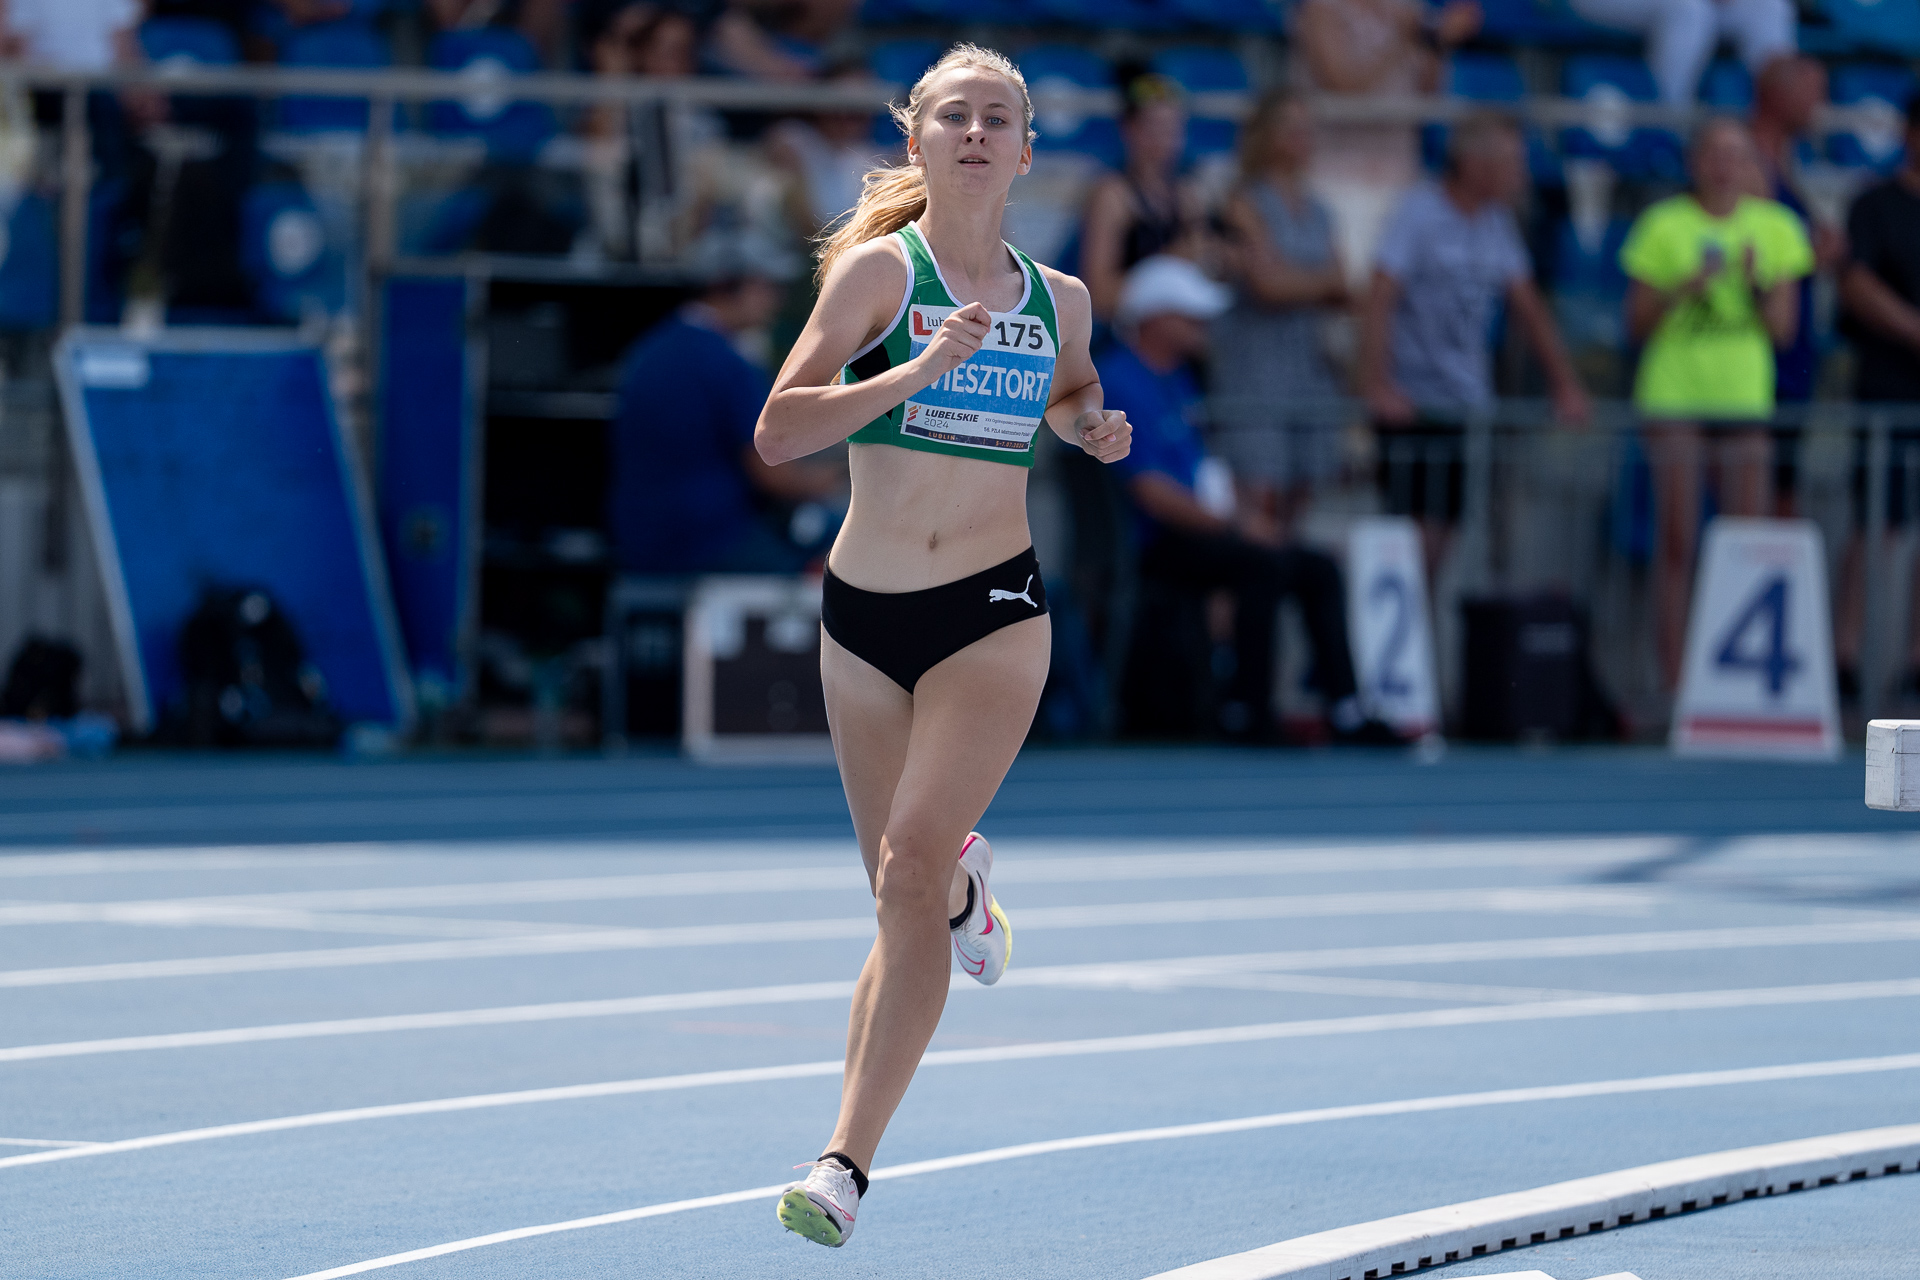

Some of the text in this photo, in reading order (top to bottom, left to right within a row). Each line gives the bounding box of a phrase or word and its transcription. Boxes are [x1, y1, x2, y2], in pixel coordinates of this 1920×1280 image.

[927, 316, 944, 327] lub
[994, 321, 1044, 350] 175
[924, 417, 949, 429] 2024
[925, 408, 980, 423] LUBELSKIE
[928, 431, 956, 441] LUBLIN
[1368, 571, 1413, 697] 2
[1714, 575, 1804, 698] 4
